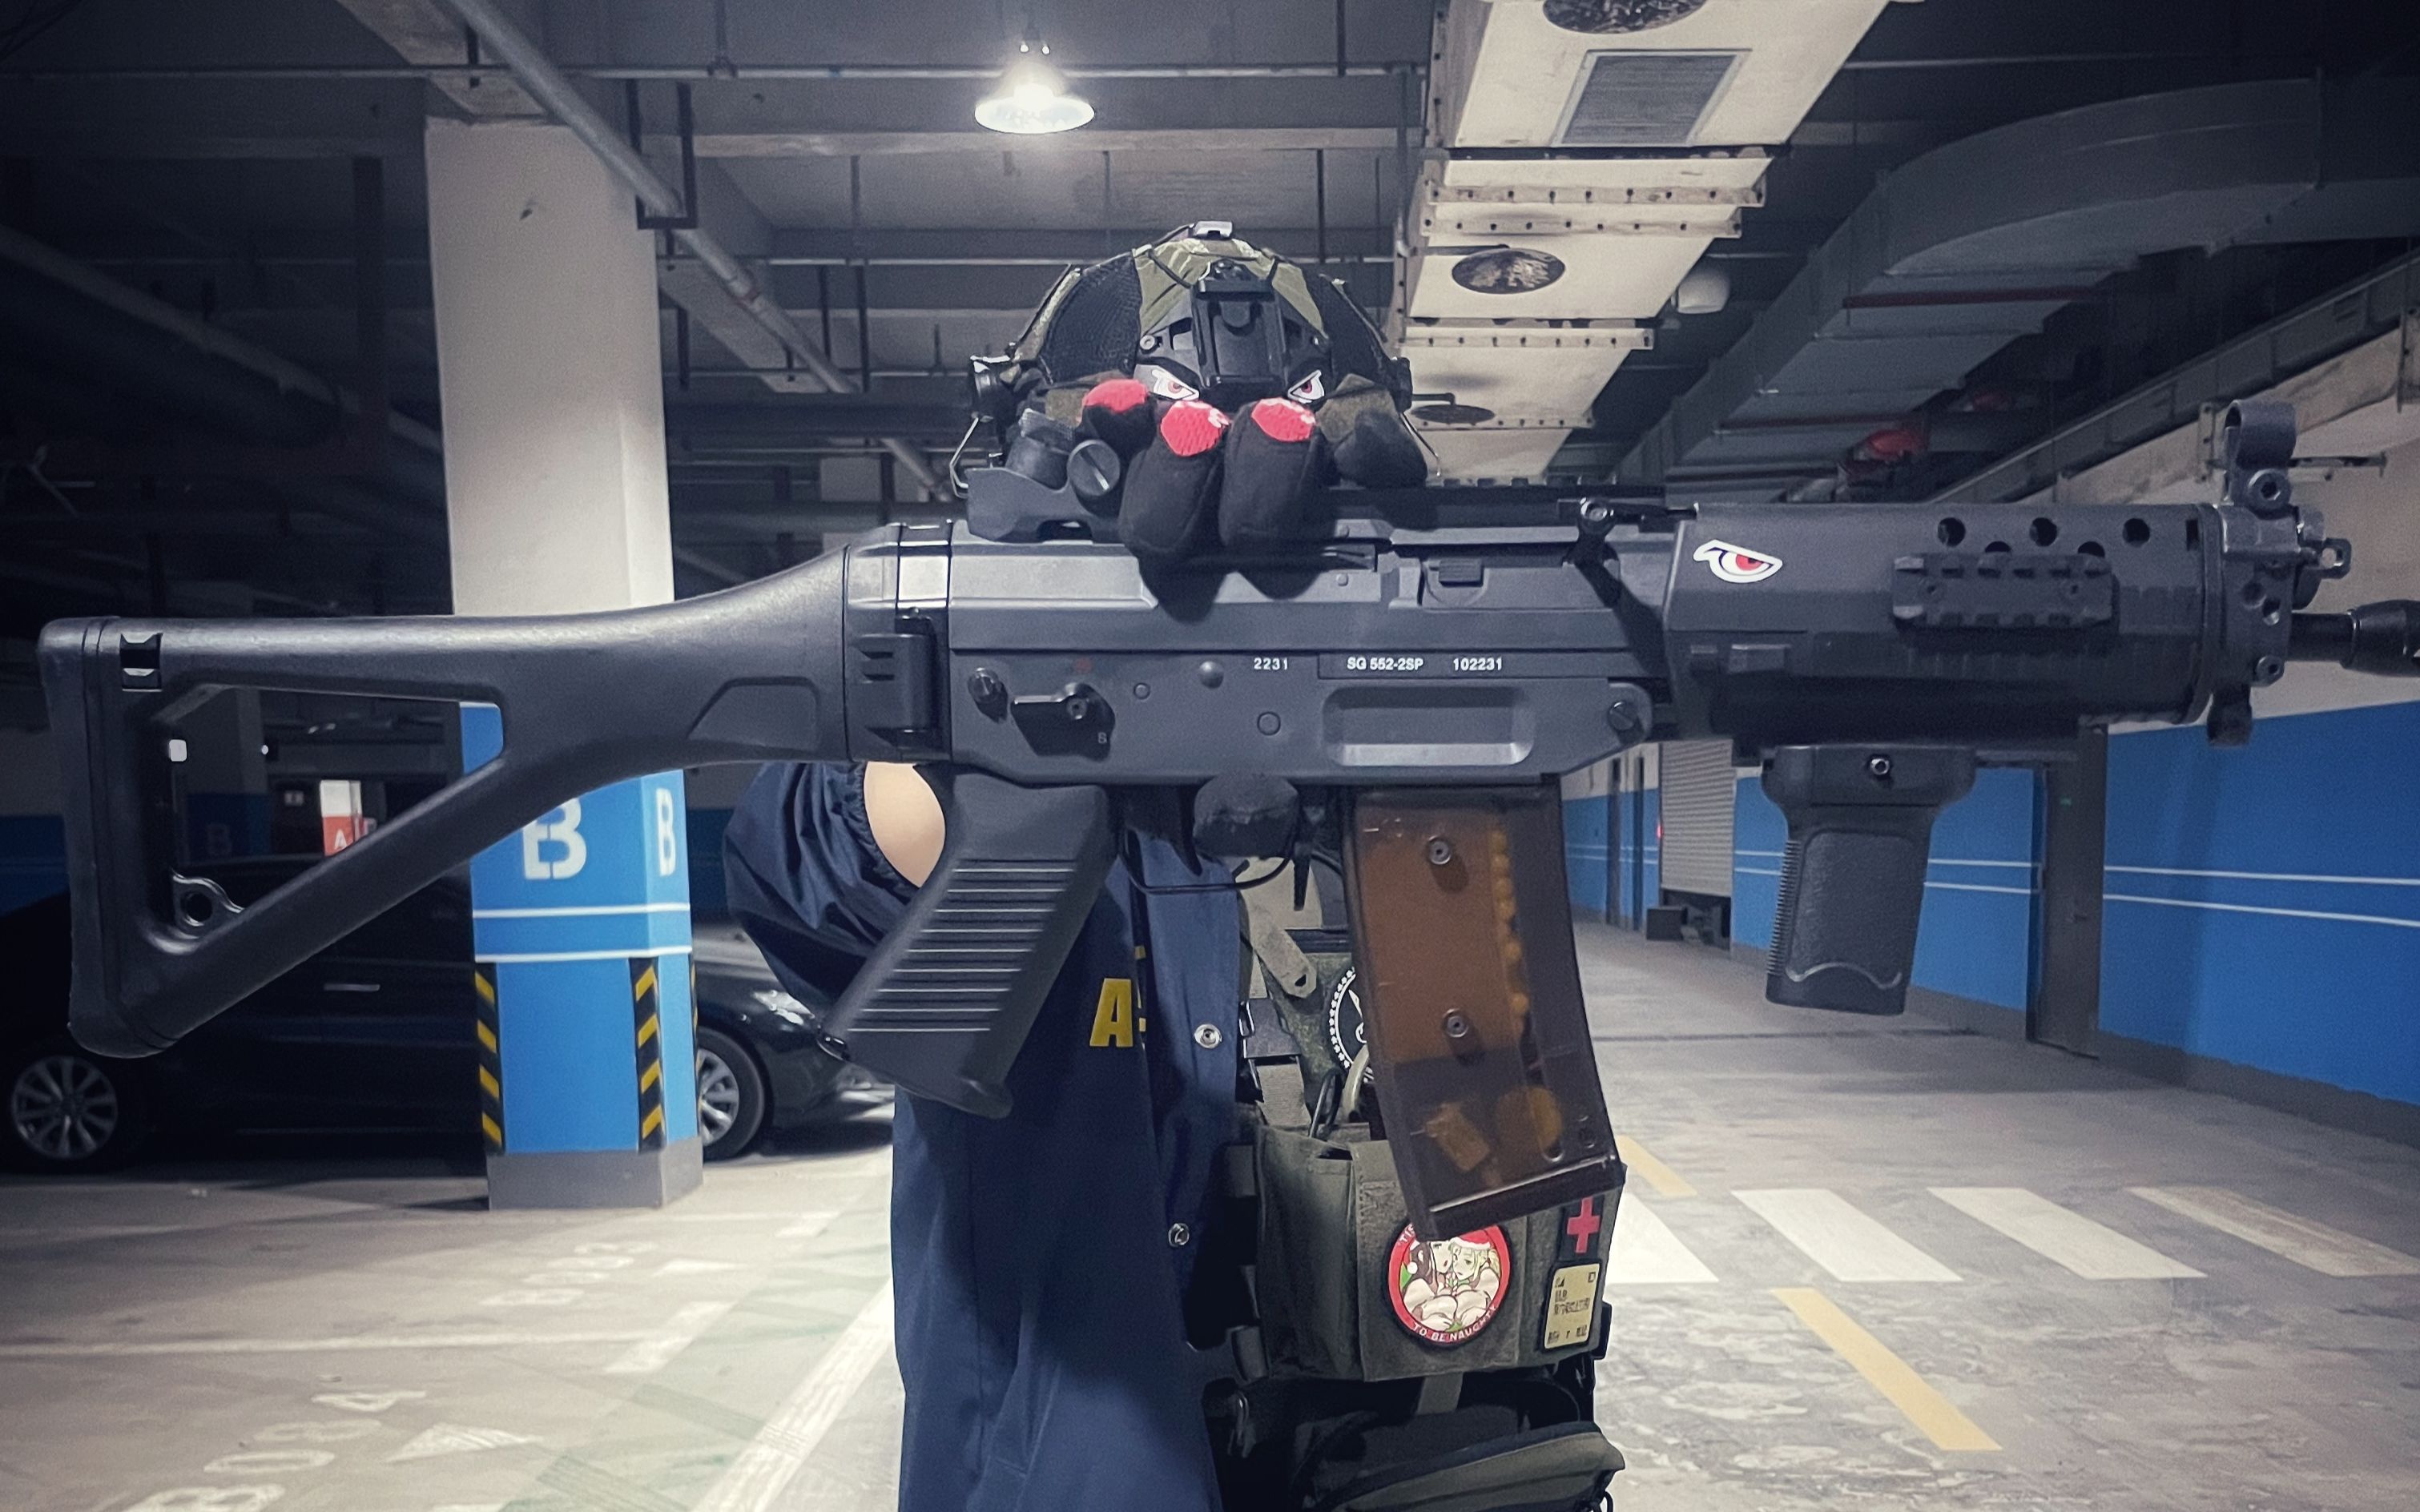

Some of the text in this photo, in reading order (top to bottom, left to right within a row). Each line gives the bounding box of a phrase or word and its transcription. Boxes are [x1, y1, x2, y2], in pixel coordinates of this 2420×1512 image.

[1254, 657, 1288, 670] 2231
[1347, 657, 1502, 671] SG 552-2SP 102231
[335, 830, 348, 850] A
[521, 798, 587, 880] B
[655, 787, 676, 877] B
[1089, 978, 1146, 1047] A
[1413, 1323, 1427, 1336] TO
[1431, 1331, 1448, 1342] BE
